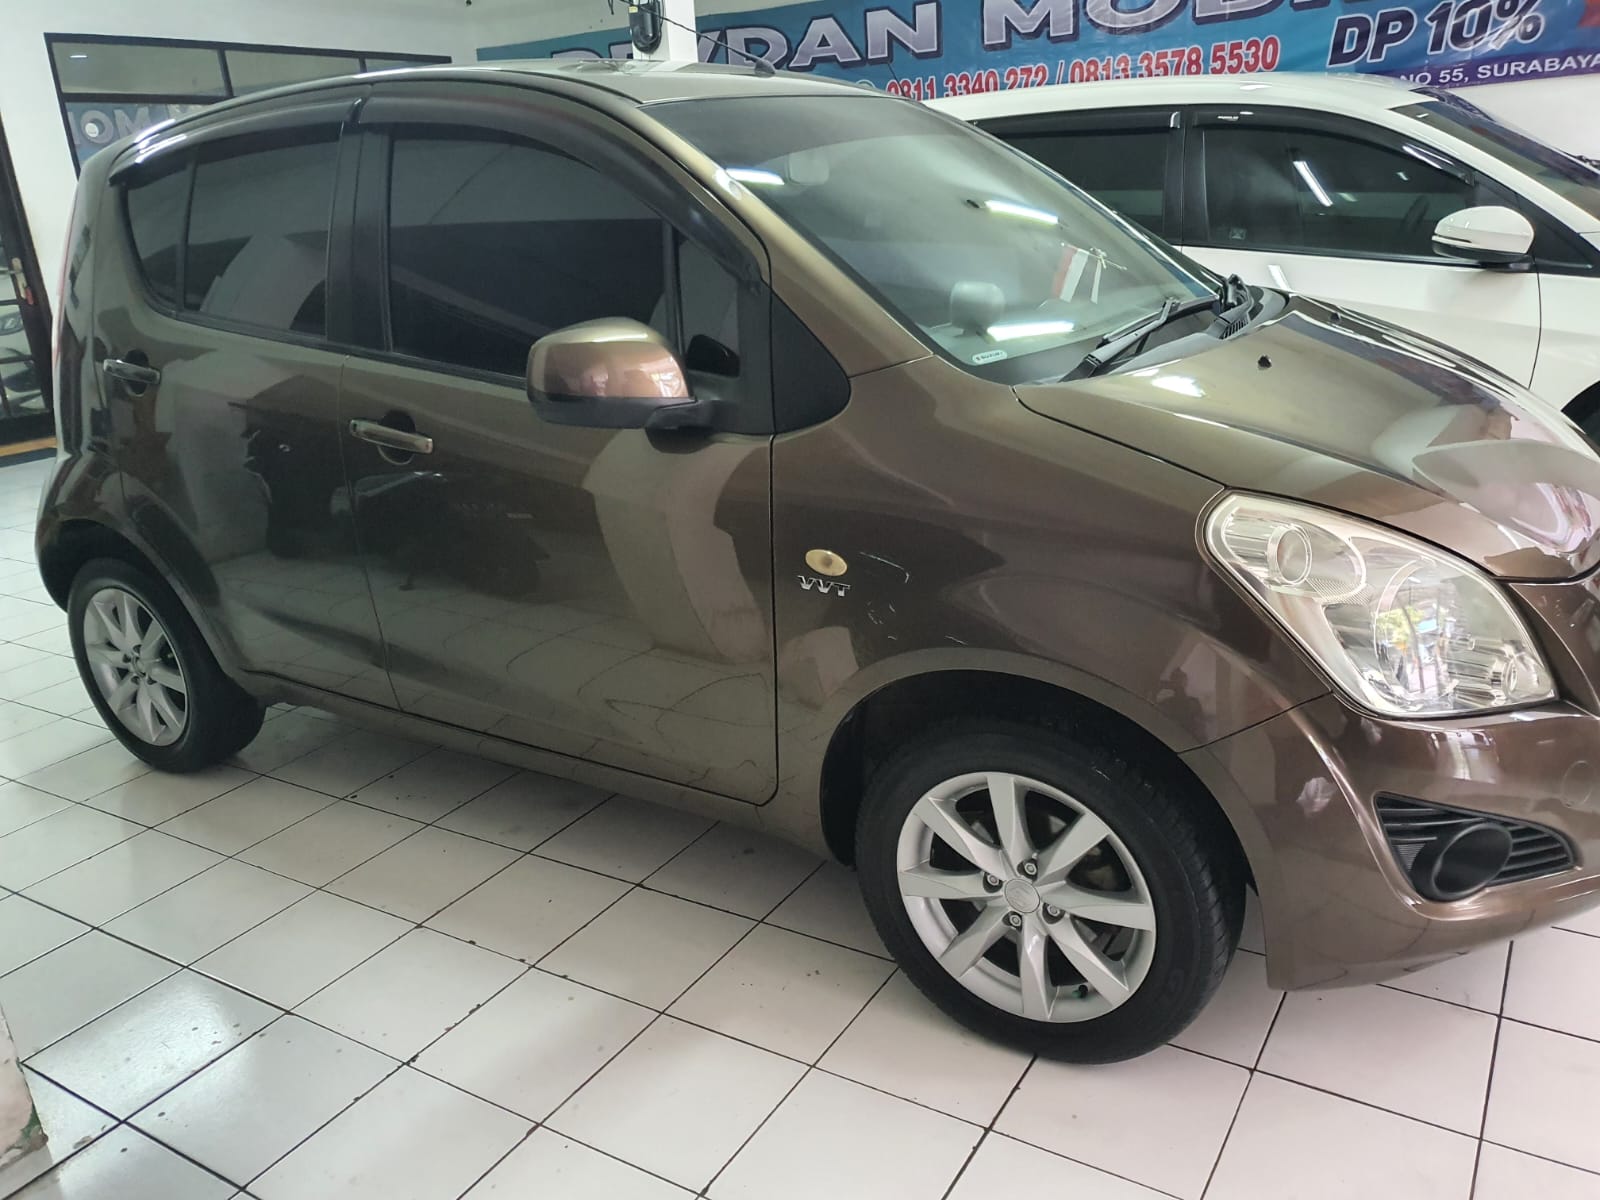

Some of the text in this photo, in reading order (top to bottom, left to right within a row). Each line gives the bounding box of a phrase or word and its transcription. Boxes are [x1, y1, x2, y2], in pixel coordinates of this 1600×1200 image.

[1327, 0, 1545, 67] DP 10%
[943, 69, 999, 97] 3340
[1004, 63, 1048, 89] 272
[1069, 54, 1131, 83] 0813
[1137, 46, 1203, 78] 3578
[1209, 35, 1281, 75] 5530
[1438, 68, 1469, 84] 55,
[1477, 53, 1600, 79] SURABAYA
[797, 575, 851, 597] VVT
